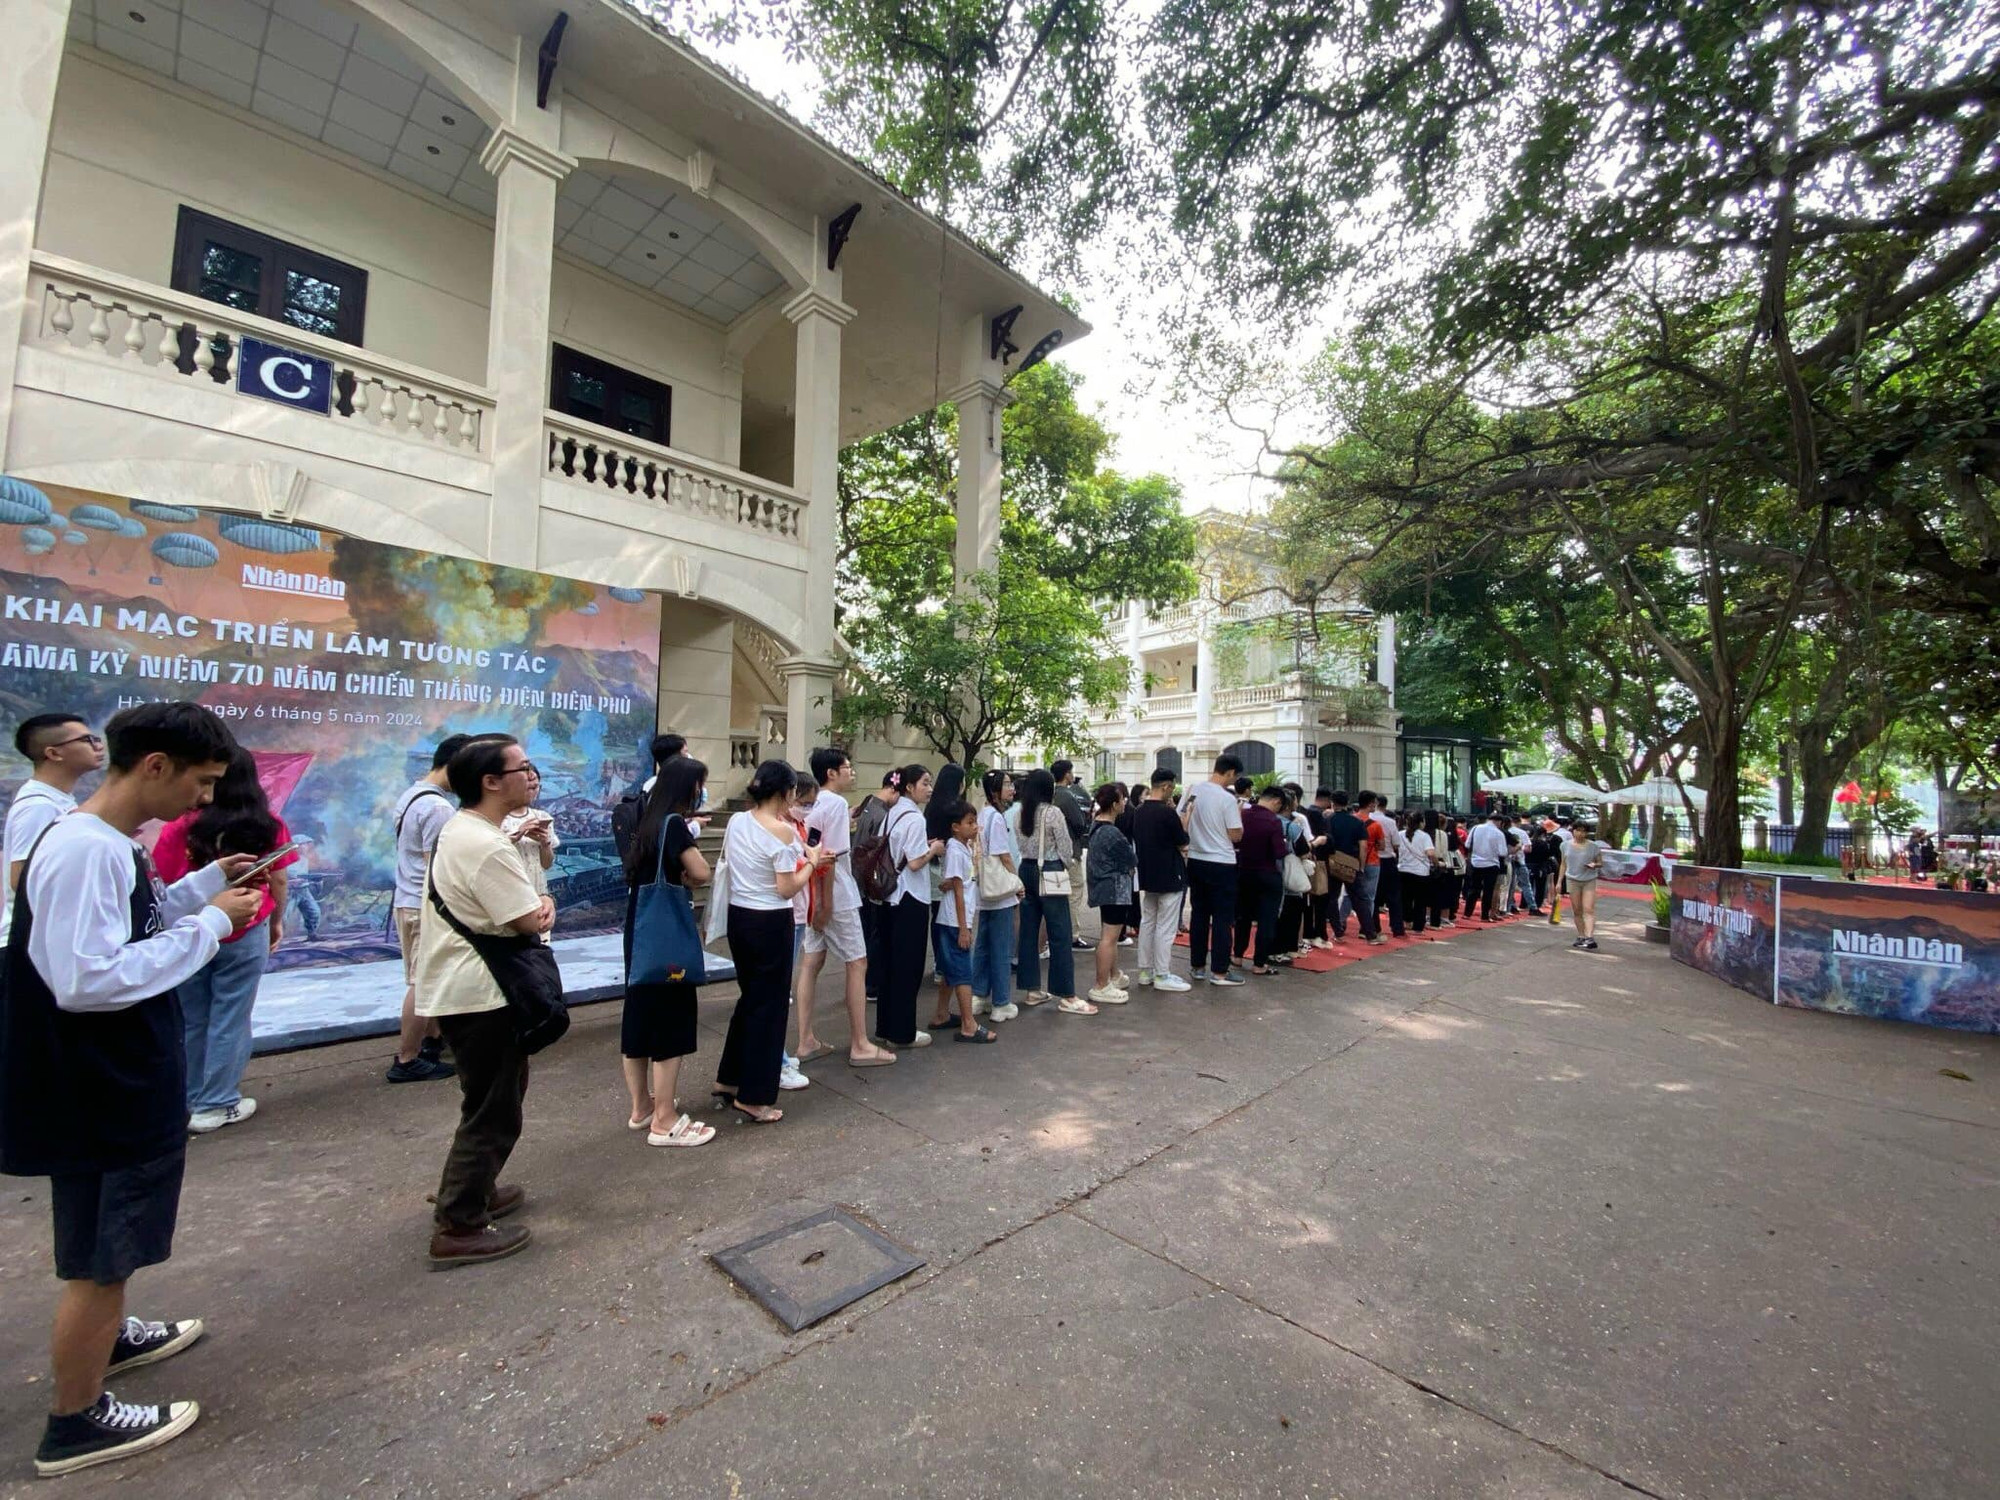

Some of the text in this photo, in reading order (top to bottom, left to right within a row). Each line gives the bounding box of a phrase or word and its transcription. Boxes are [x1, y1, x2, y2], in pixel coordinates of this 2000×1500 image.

[260, 356, 312, 400] C
[242, 563, 346, 598] Nhân Dân
[5, 594, 547, 674] KHAI MẠC TRIỂN LÃM TƯƠNG TÁC
[1, 642, 78, 672] AMA
[89, 647, 130, 675] KỶ
[139, 653, 219, 683] NIỆM
[229, 662, 264, 686] 70
[273, 664, 337, 692] NĂM
[345, 670, 415, 698] CHIẾN
[422, 675, 492, 704] THẮNG
[499, 685, 545, 710] ĐIỆN
[550, 690, 592, 712] BIÊN
[254, 704, 265, 718] 6
[271, 706, 322, 724] tháng
[328, 709, 338, 722] 5
[344, 712, 380, 724] năm
[386, 712, 422, 726] 2024
[1832, 929, 1963, 963] Nhân Dân
